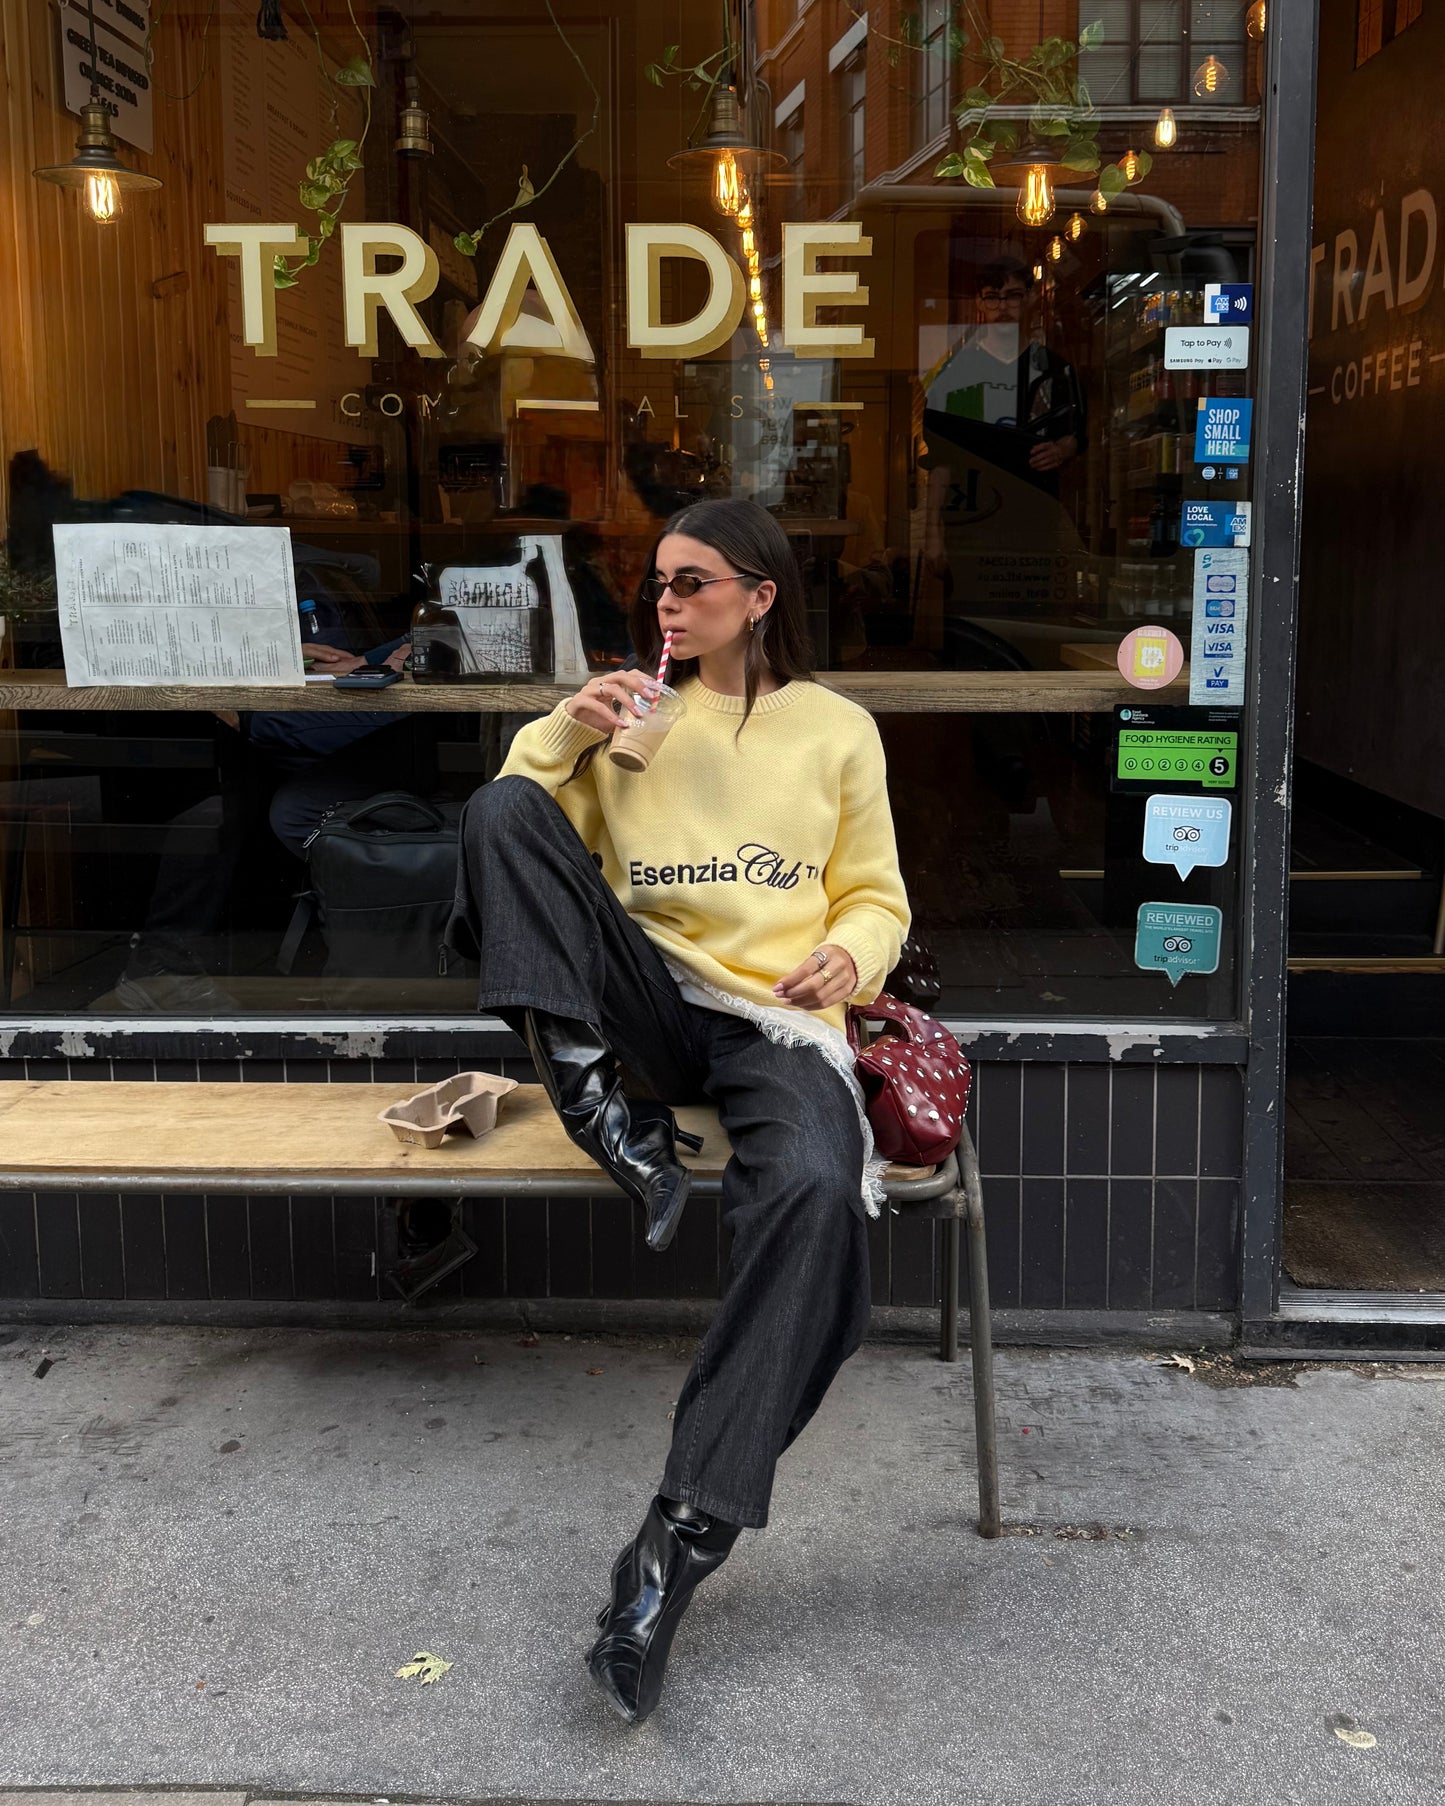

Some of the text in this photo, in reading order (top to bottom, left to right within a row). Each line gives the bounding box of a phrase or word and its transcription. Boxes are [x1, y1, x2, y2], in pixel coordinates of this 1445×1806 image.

[66, 28, 97, 58] GREE
[1308, 189, 1445, 341] TRAD
[204, 222, 876, 363] TRADE
[1181, 340, 1195, 348] Tap
[1206, 340, 1222, 348] Pay
[1331, 340, 1423, 405] COFFEE
[1208, 408, 1240, 424] SHOP
[1204, 424, 1242, 440] SMALL
[1207, 440, 1237, 456] HERE
[1186, 513, 1214, 521] LOCAL
[1187, 506, 1209, 514] LOVE
[1207, 623, 1235, 634] VISA
[1208, 642, 1232, 652] VISA
[1210, 680, 1225, 688] PAY
[1125, 735, 1231, 745] FOOD HYGIENE RATING
[1213, 759, 1225, 774] 5
[1152, 806, 1223, 819] REVIEW US
[629, 856, 738, 886] Esenzia
[737, 843, 802, 890] Club
[1146, 912, 1214, 927] REVIEWED
[1153, 954, 1198, 965] tripadvisor
